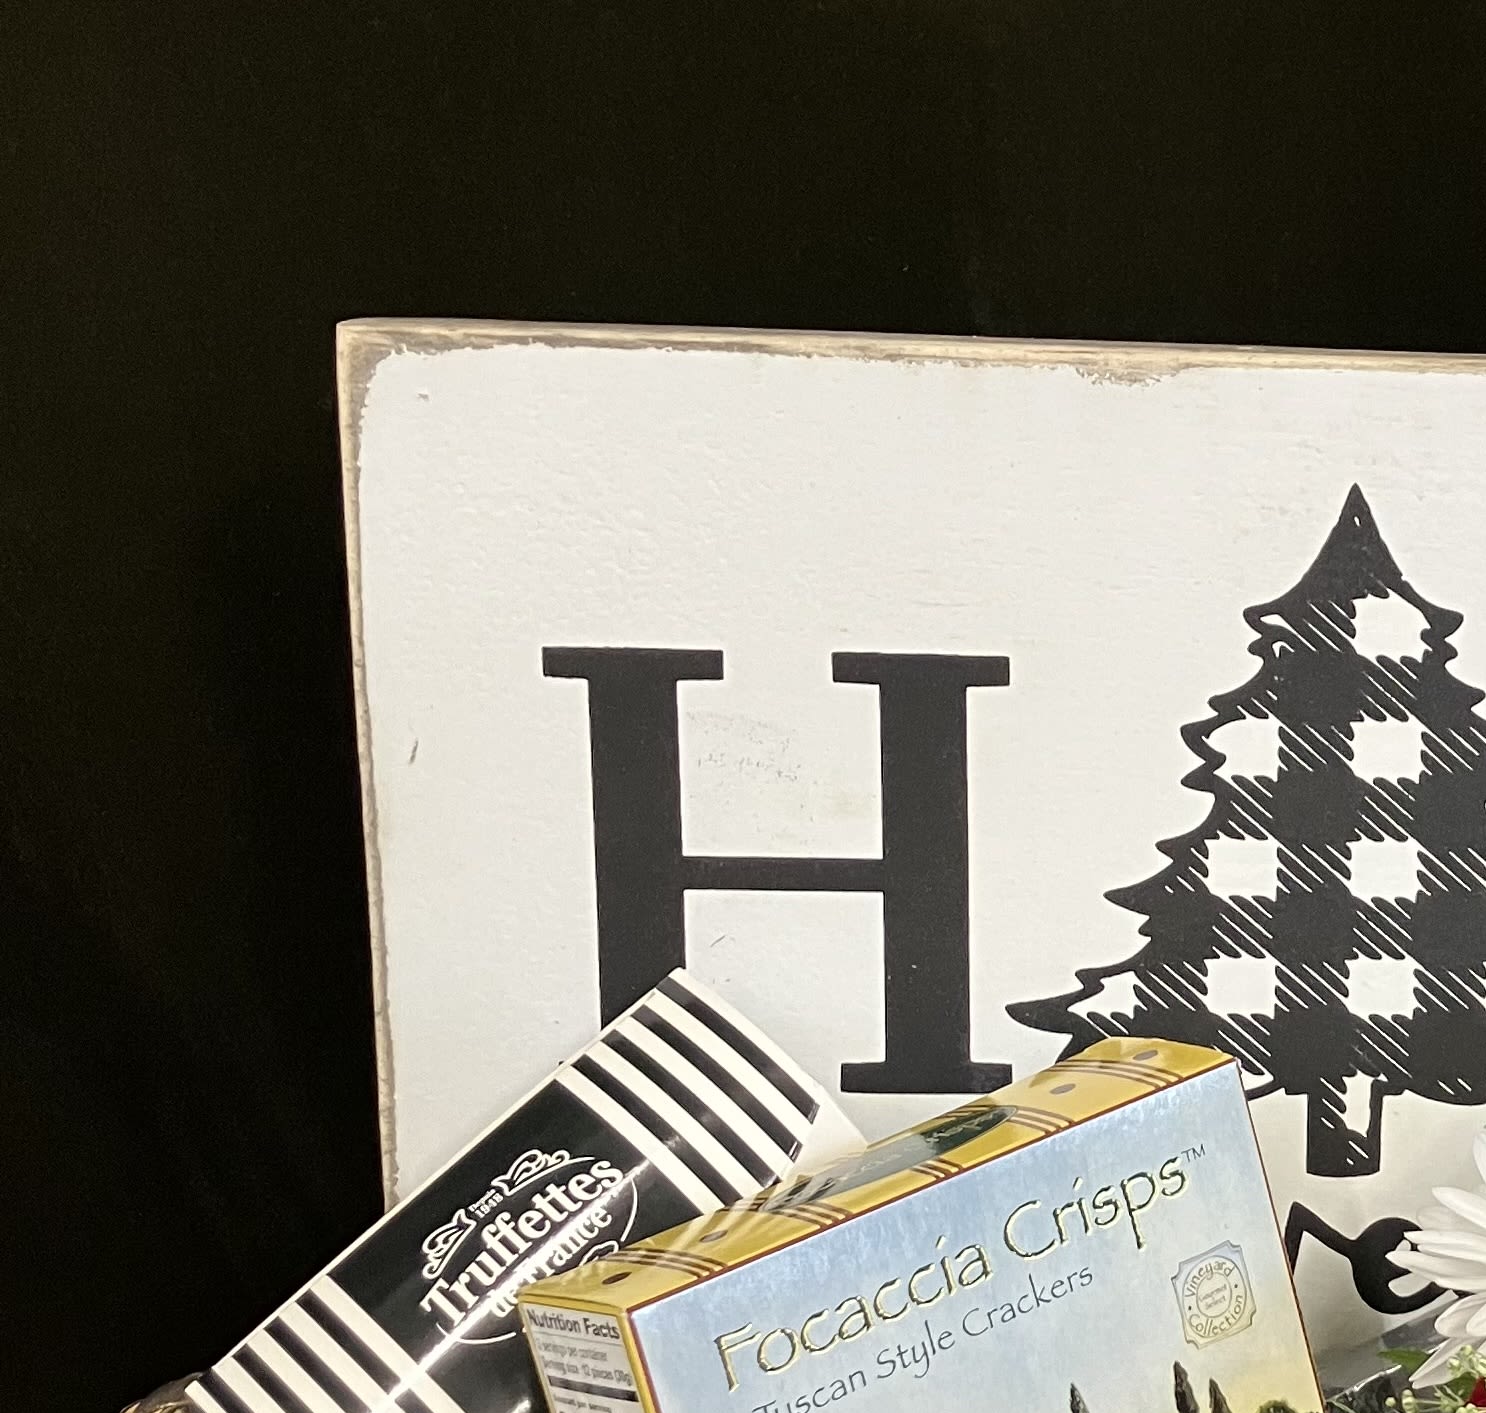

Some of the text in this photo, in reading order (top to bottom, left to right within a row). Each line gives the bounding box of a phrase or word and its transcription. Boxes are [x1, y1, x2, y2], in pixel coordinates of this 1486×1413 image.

[419, 1160, 624, 1327] Truffettes
[1184, 1261, 1236, 1297] Vineyard
[526, 1309, 620, 1339] Nutrition Facts
[712, 1235, 995, 1393] Focaccia
[876, 1320, 957, 1379] Style
[962, 1263, 1094, 1336] Crackers
[1189, 1295, 1243, 1336] Collection
